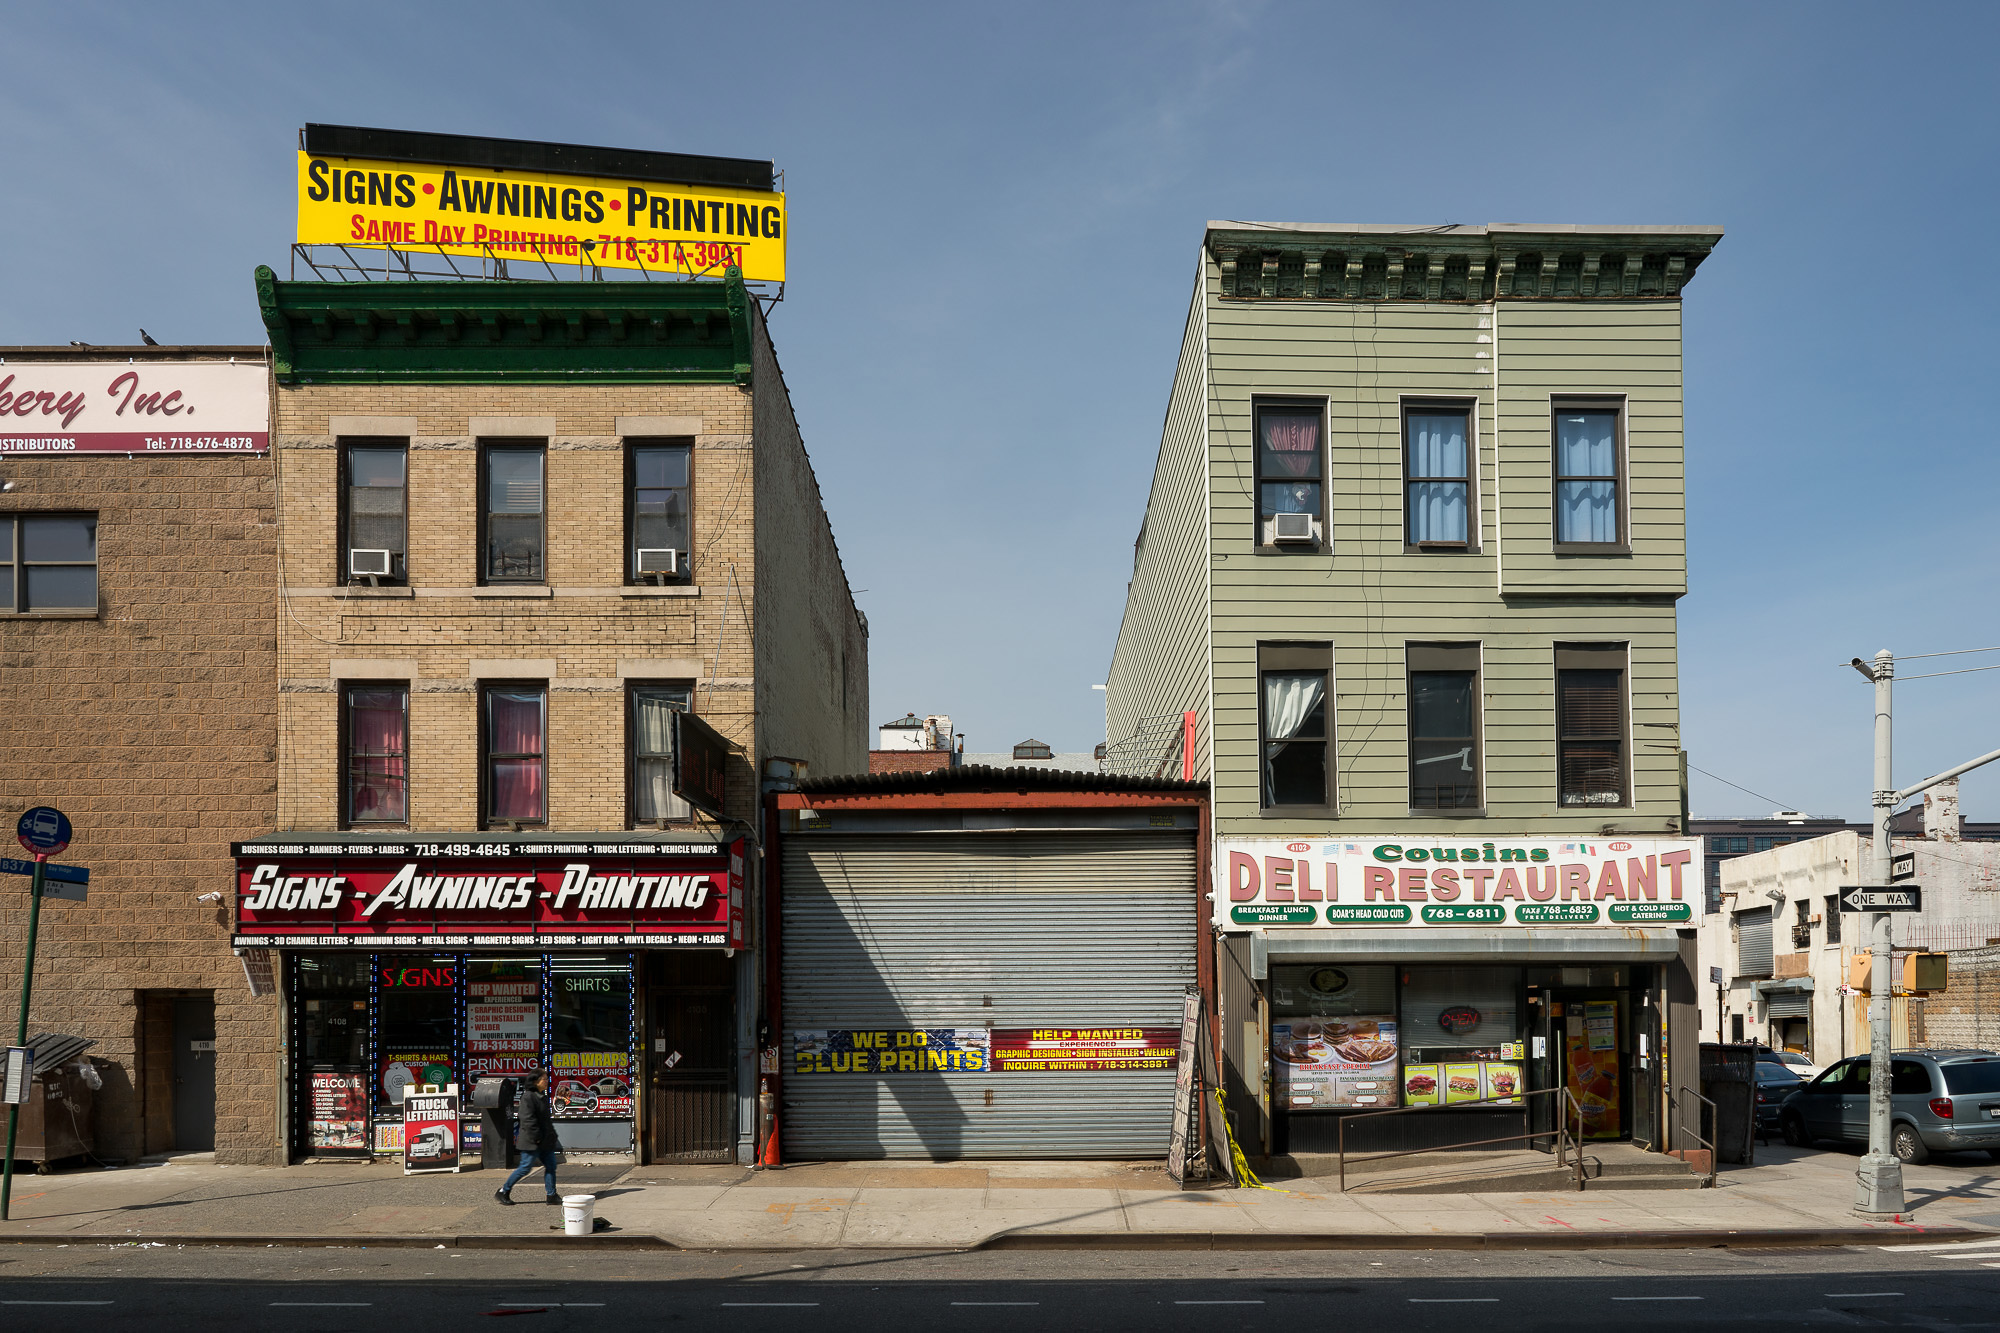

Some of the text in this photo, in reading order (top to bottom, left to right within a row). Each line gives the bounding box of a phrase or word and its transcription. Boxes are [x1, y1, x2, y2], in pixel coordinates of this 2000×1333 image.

[307, 159, 781, 239] SIGNS AWNINGS PRINTING
[350, 214, 744, 270] SAME DAY PRINTING 718-314-3991
[107, 371, 195, 416] Inc.
[145, 438, 253, 450] Tel: 718-676-4878
[31, 843, 65, 854] STANDING
[241, 844, 717, 856] BUSINESS CARDS BANNERS FLYERS LABELS 718-499-4645 T-SHIRTS PRINTING TRUCK LETTERING VEHICLE WRAPS
[1290, 843, 1308, 852] 4102
[1372, 842, 1550, 862] Cousins
[1612, 842, 1629, 851] 4102
[2, 860, 27, 872] B37
[1897, 861, 1911, 873] WAY
[1229, 848, 1692, 902] DELI RESTAURANT
[243, 864, 347, 911] SIGNS
[360, 863, 536, 917] AWNINGS
[553, 864, 710, 910] PRINTING
[1852, 894, 1911, 904] ONE WAY
[1237, 906, 1309, 914] BREAKFAST LUNCH
[1332, 908, 1405, 919] BOAR'S HEAD COLD CUTS
[1614, 904, 1684, 912] HOT & COLD HEROS
[234, 935, 725, 945] AWNINGS 3D CHANNEL LETTERS ALUMINUM SIGNS METAL SIGNS MAGNETIC SIGNS LED SIGNS LIGHT BOX VINYL DECALS NEON FLAGS
[382, 968, 454, 987] SIGNS
[470, 983, 536, 996] HEP WANTED
[565, 978, 611, 992] SHIRTS
[474, 1006, 504, 1014] GRAPHIC
[328, 1018, 347, 1026] 4108
[852, 1031, 928, 1048] WE DO
[1032, 1028, 1143, 1040] HELP WANTED
[472, 1040, 535, 1051] 718-314-3991
[995, 1048, 1176, 1059] GRAPHIC DESIGNER SIGN INSTALLER WELDER
[468, 1058, 539, 1070] PRINTING
[552, 1052, 628, 1068] CAR WRAPS
[795, 1051, 869, 1073] BLUE
[880, 1050, 983, 1071] PRINTS
[1003, 1061, 1046, 1070] INQUIRE
[1049, 1061, 1087, 1070] WITHIN
[587, 1068, 628, 1076] GRAPHICS
[1299, 1063, 1341, 1071] BREAKFAST
[312, 1078, 361, 1088] WELCOME
[410, 1098, 449, 1110] TRUCK
[1580, 1102, 1606, 1113] Snapple
[406, 1109, 456, 1122] LETTERING
